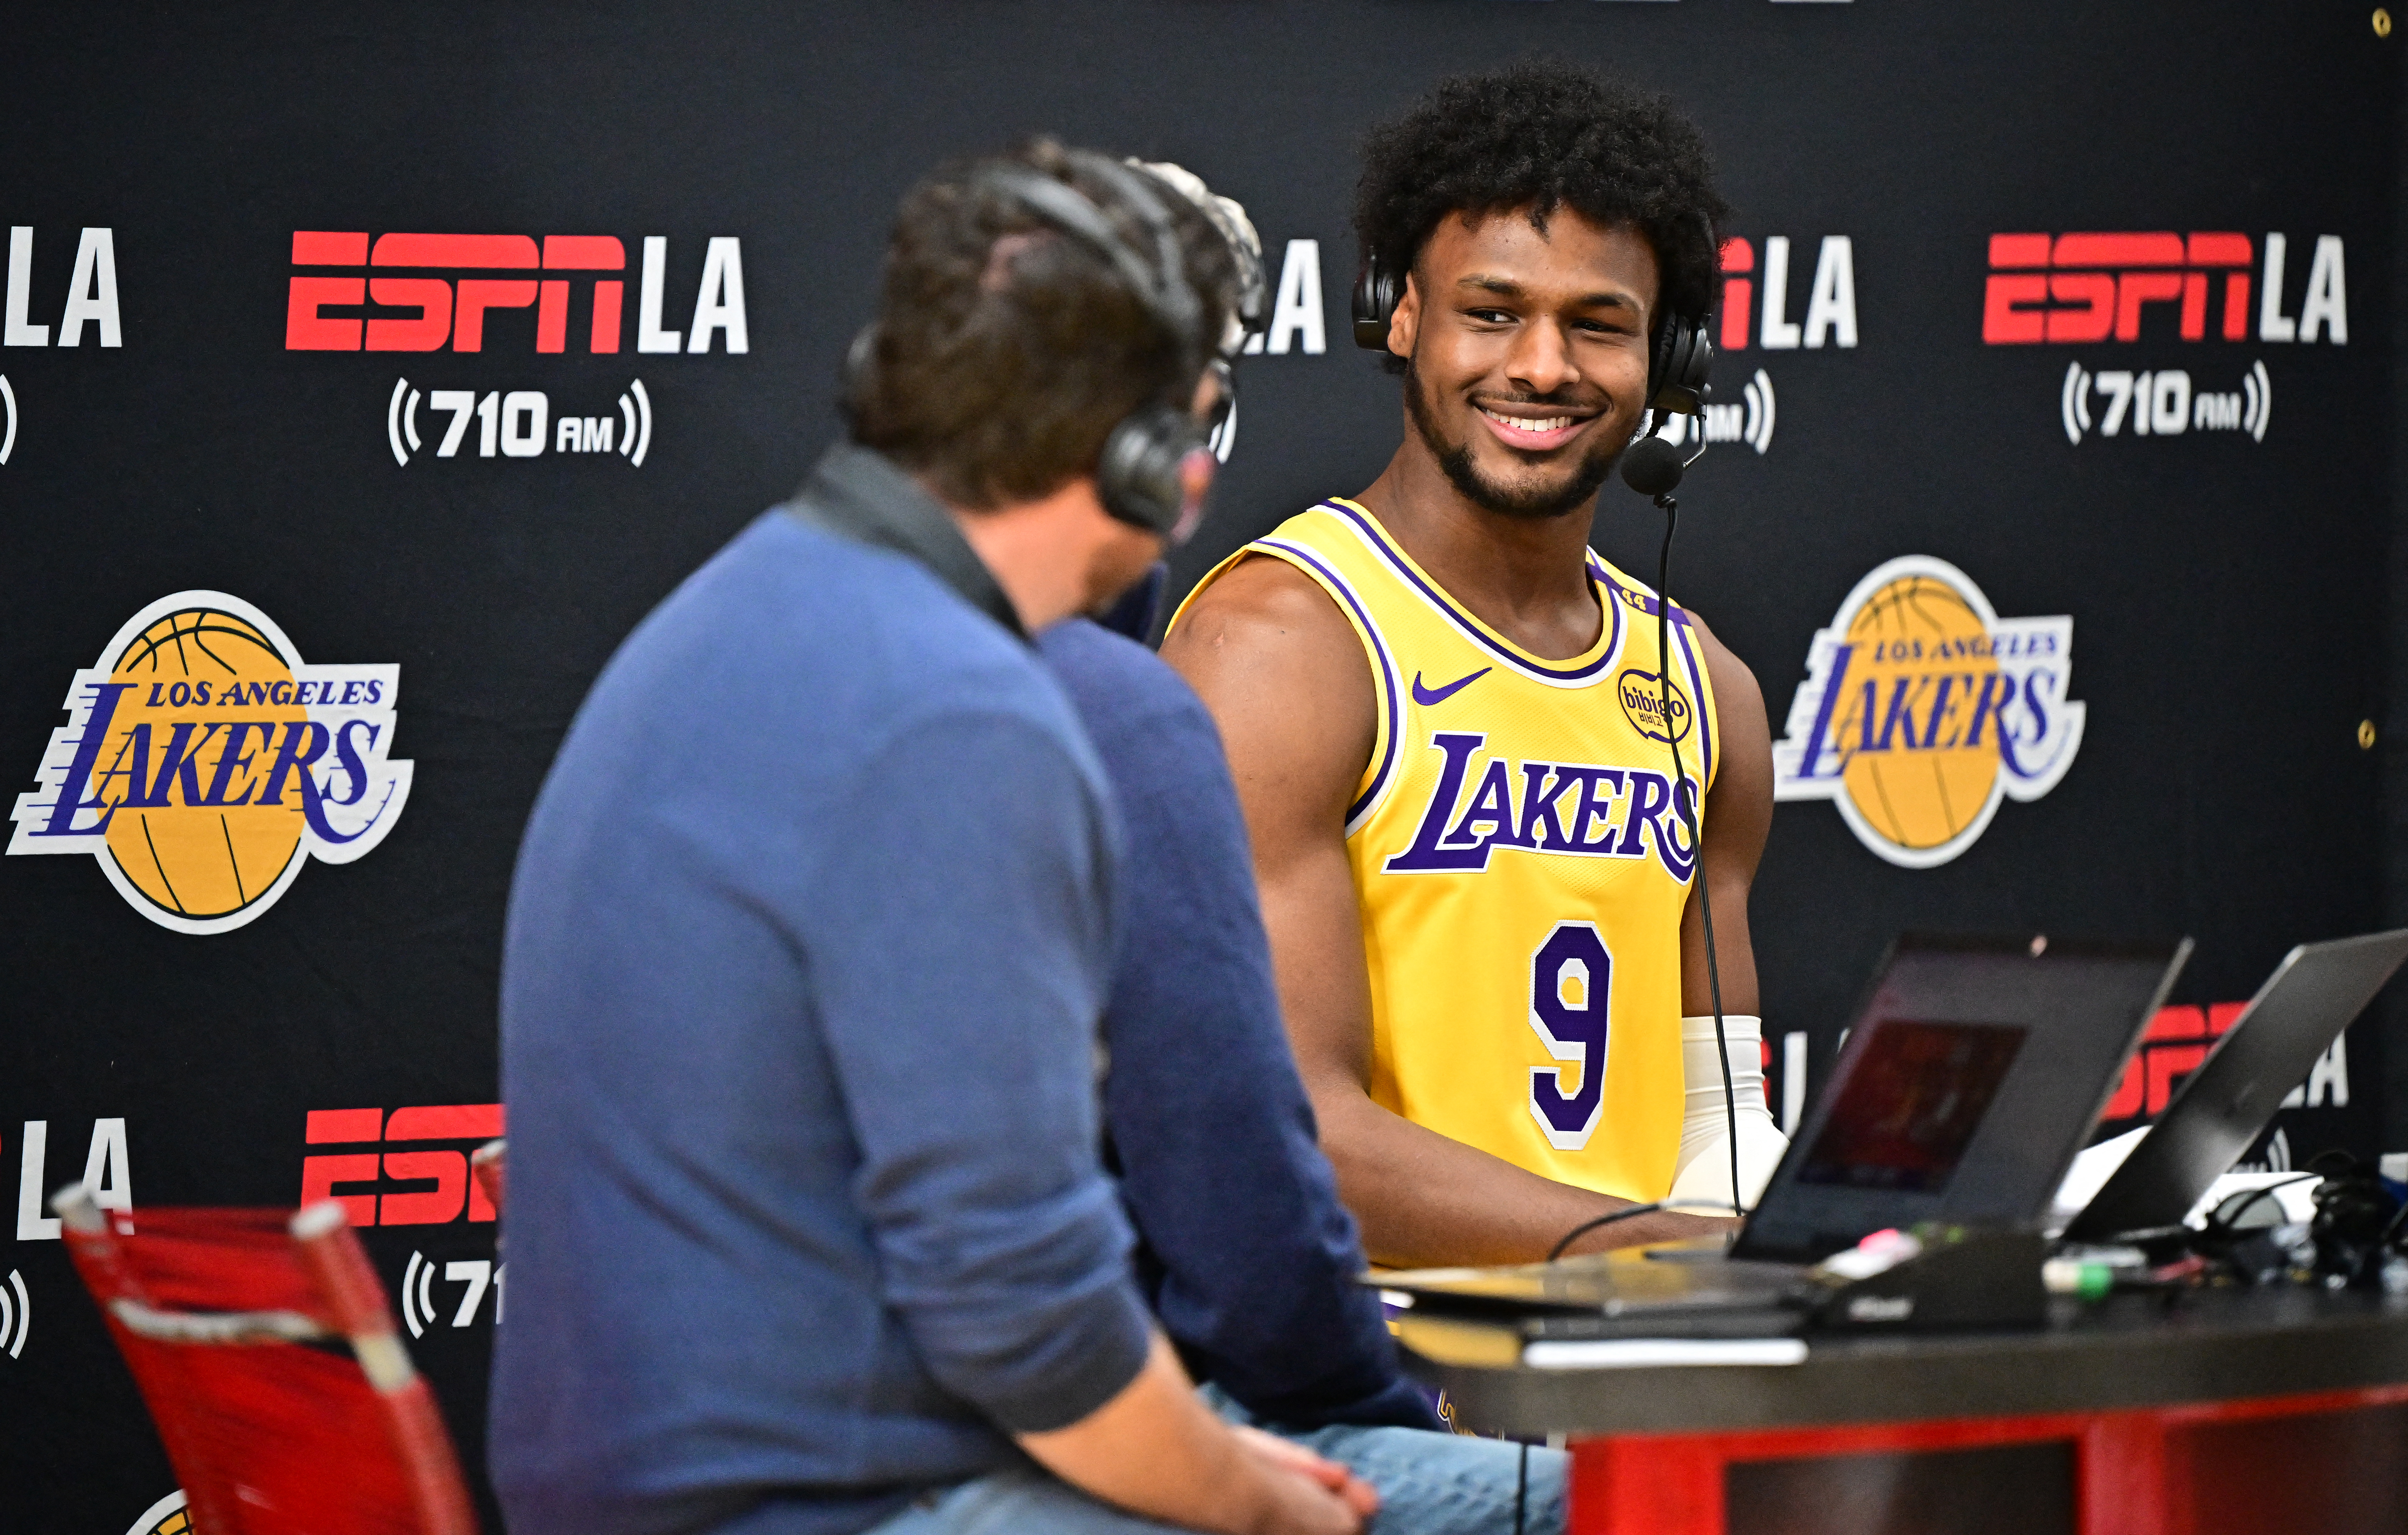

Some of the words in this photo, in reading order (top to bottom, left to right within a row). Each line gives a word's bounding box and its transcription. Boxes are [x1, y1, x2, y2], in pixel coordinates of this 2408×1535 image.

[4, 226, 122, 347] LA
[285, 231, 626, 353] ESPN
[638, 236, 749, 354] LA
[1243, 238, 1326, 355] A
[1760, 235, 1858, 349] LA
[1982, 231, 2253, 345] ESPN
[2259, 232, 2348, 346] LA
[430, 390, 548, 457] 710
[556, 417, 614, 453] AM
[2095, 369, 2191, 437] 710
[2194, 392, 2241, 431] AM
[145, 680, 213, 708] LOS
[216, 679, 384, 706] ANGELES
[1622, 686, 1685, 721] bibigo
[1874, 641, 1921, 662] LOS
[1929, 632, 2058, 661] ANGELES
[27, 683, 396, 844] LAKERS
[1782, 642, 2072, 781] LAKERS
[1381, 730, 1699, 886] LAKERS
[1529, 919, 1614, 1151] 9
[2279, 1029, 2350, 1108] A
[301, 1103, 507, 1226] ES
